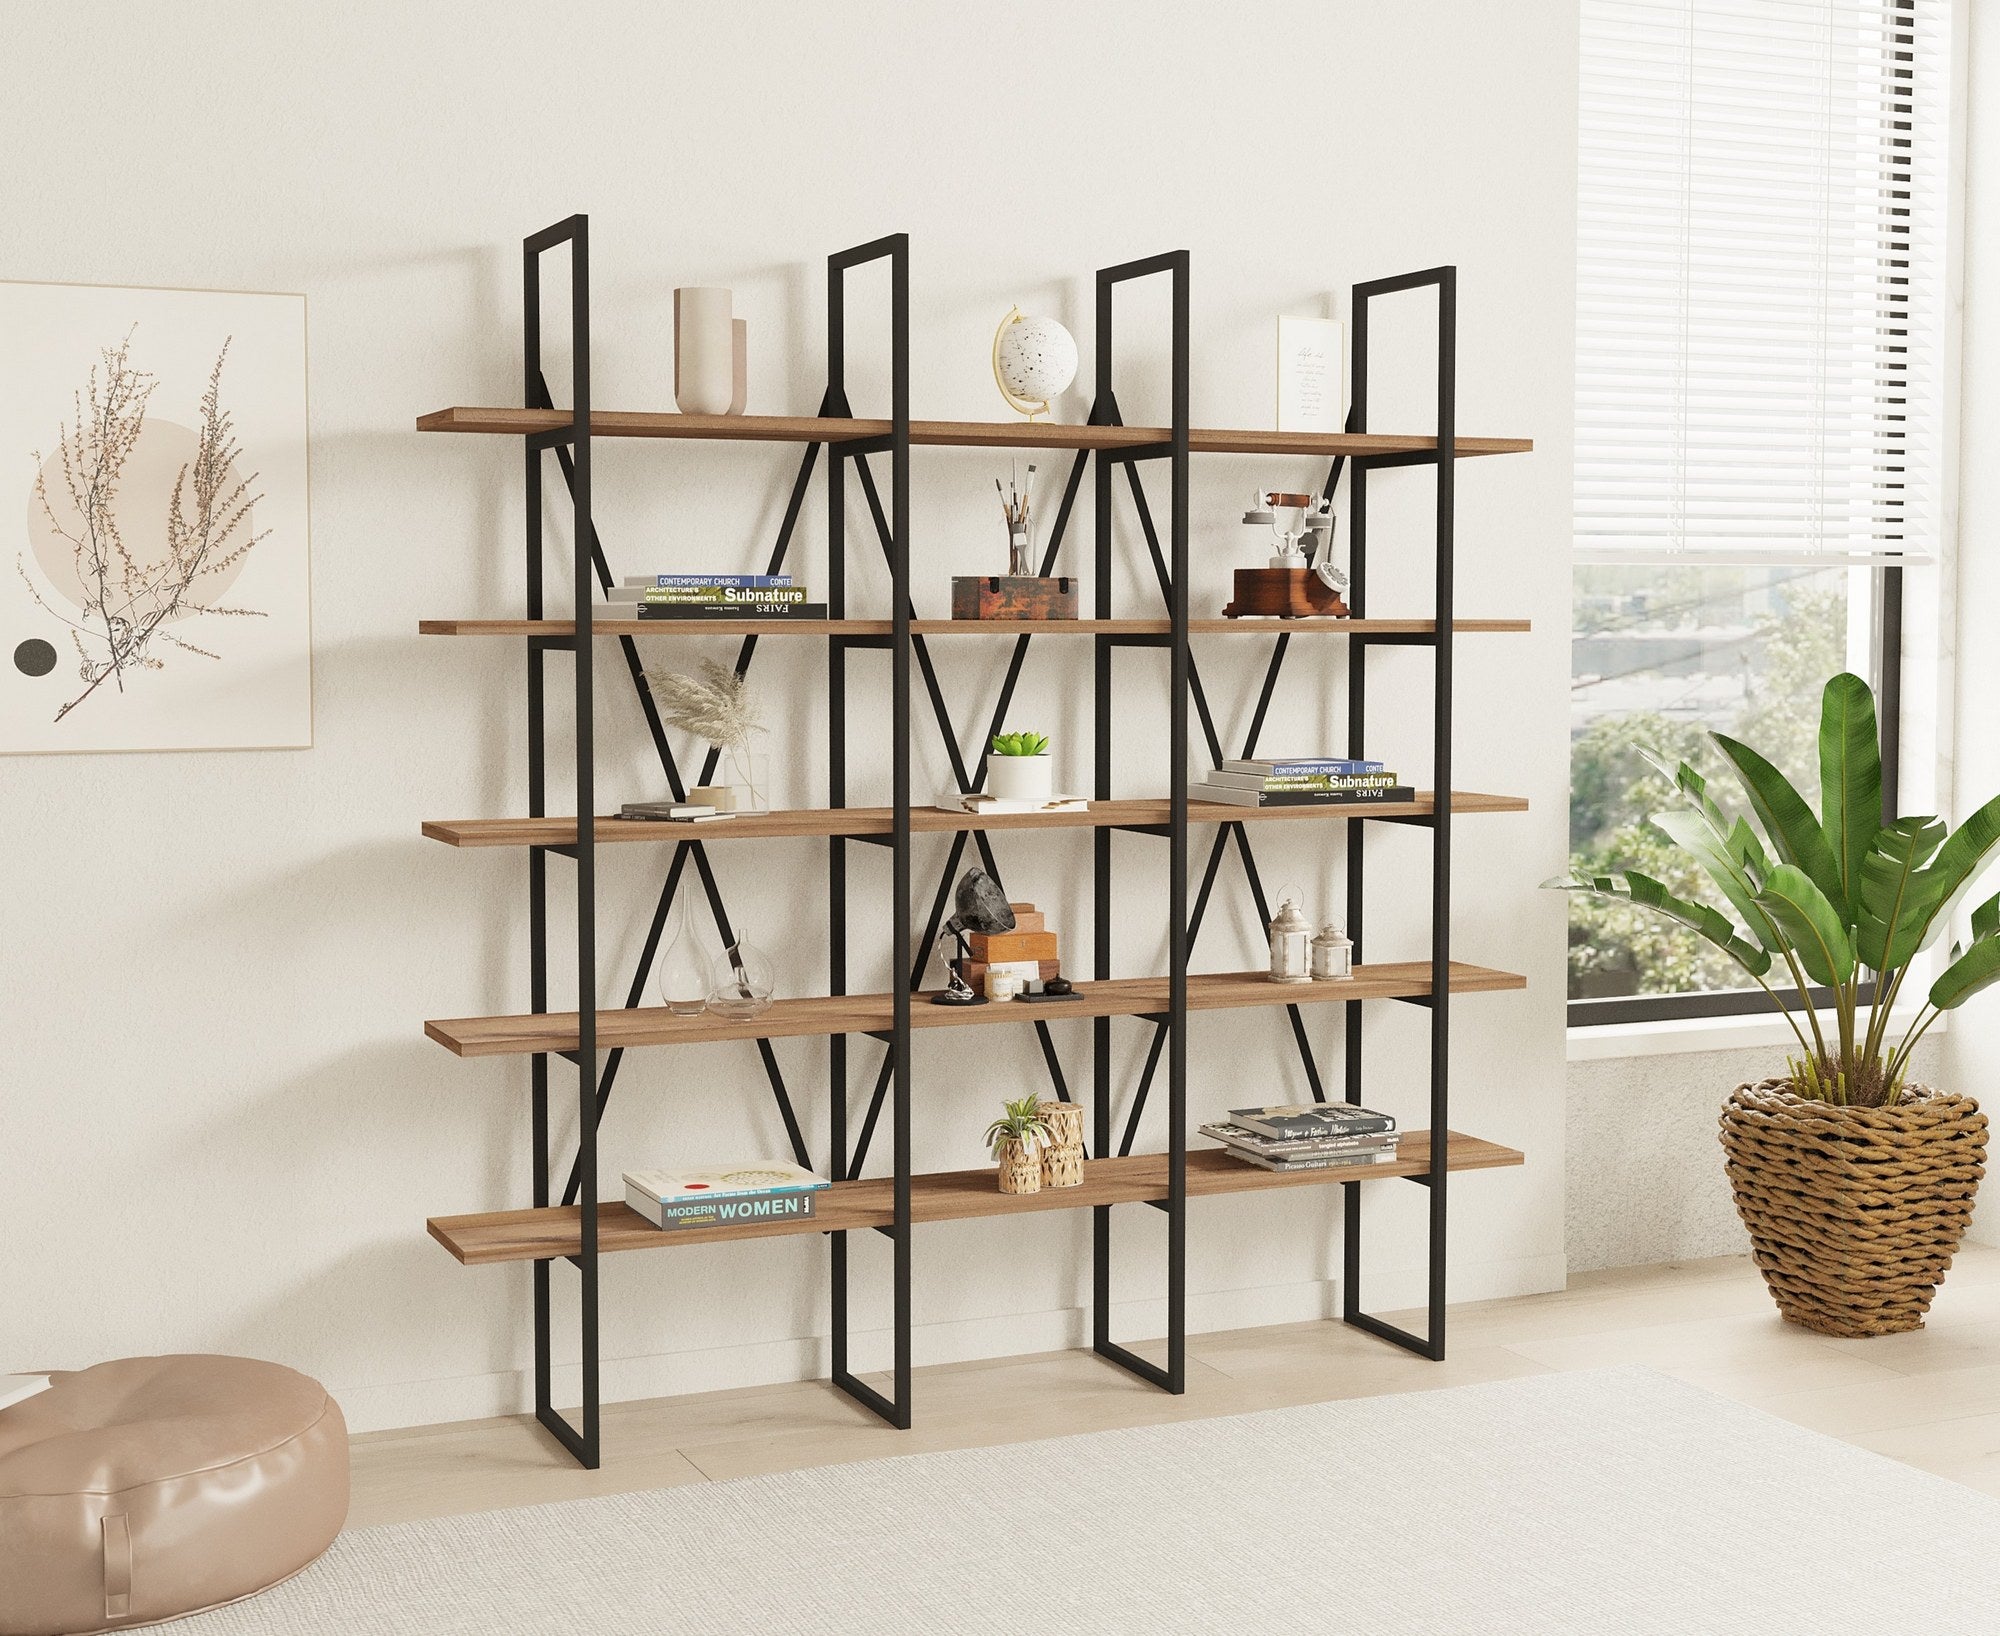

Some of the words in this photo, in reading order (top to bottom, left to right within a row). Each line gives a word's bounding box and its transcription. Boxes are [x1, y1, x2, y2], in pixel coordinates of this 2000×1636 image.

[660, 577, 712, 585] CONTEMPORARY
[714, 577, 740, 585] CHURCH
[725, 588, 803, 602] Subnature
[756, 604, 789, 613] FAIRS
[1275, 767, 1318, 775] CONTEMPORARY
[1320, 766, 1341, 774] CHURCH
[1330, 775, 1394, 788] Subnature
[1356, 789, 1383, 797] FAIRS
[668, 1205, 717, 1218] MODERN
[719, 1198, 798, 1218] WOMEN
